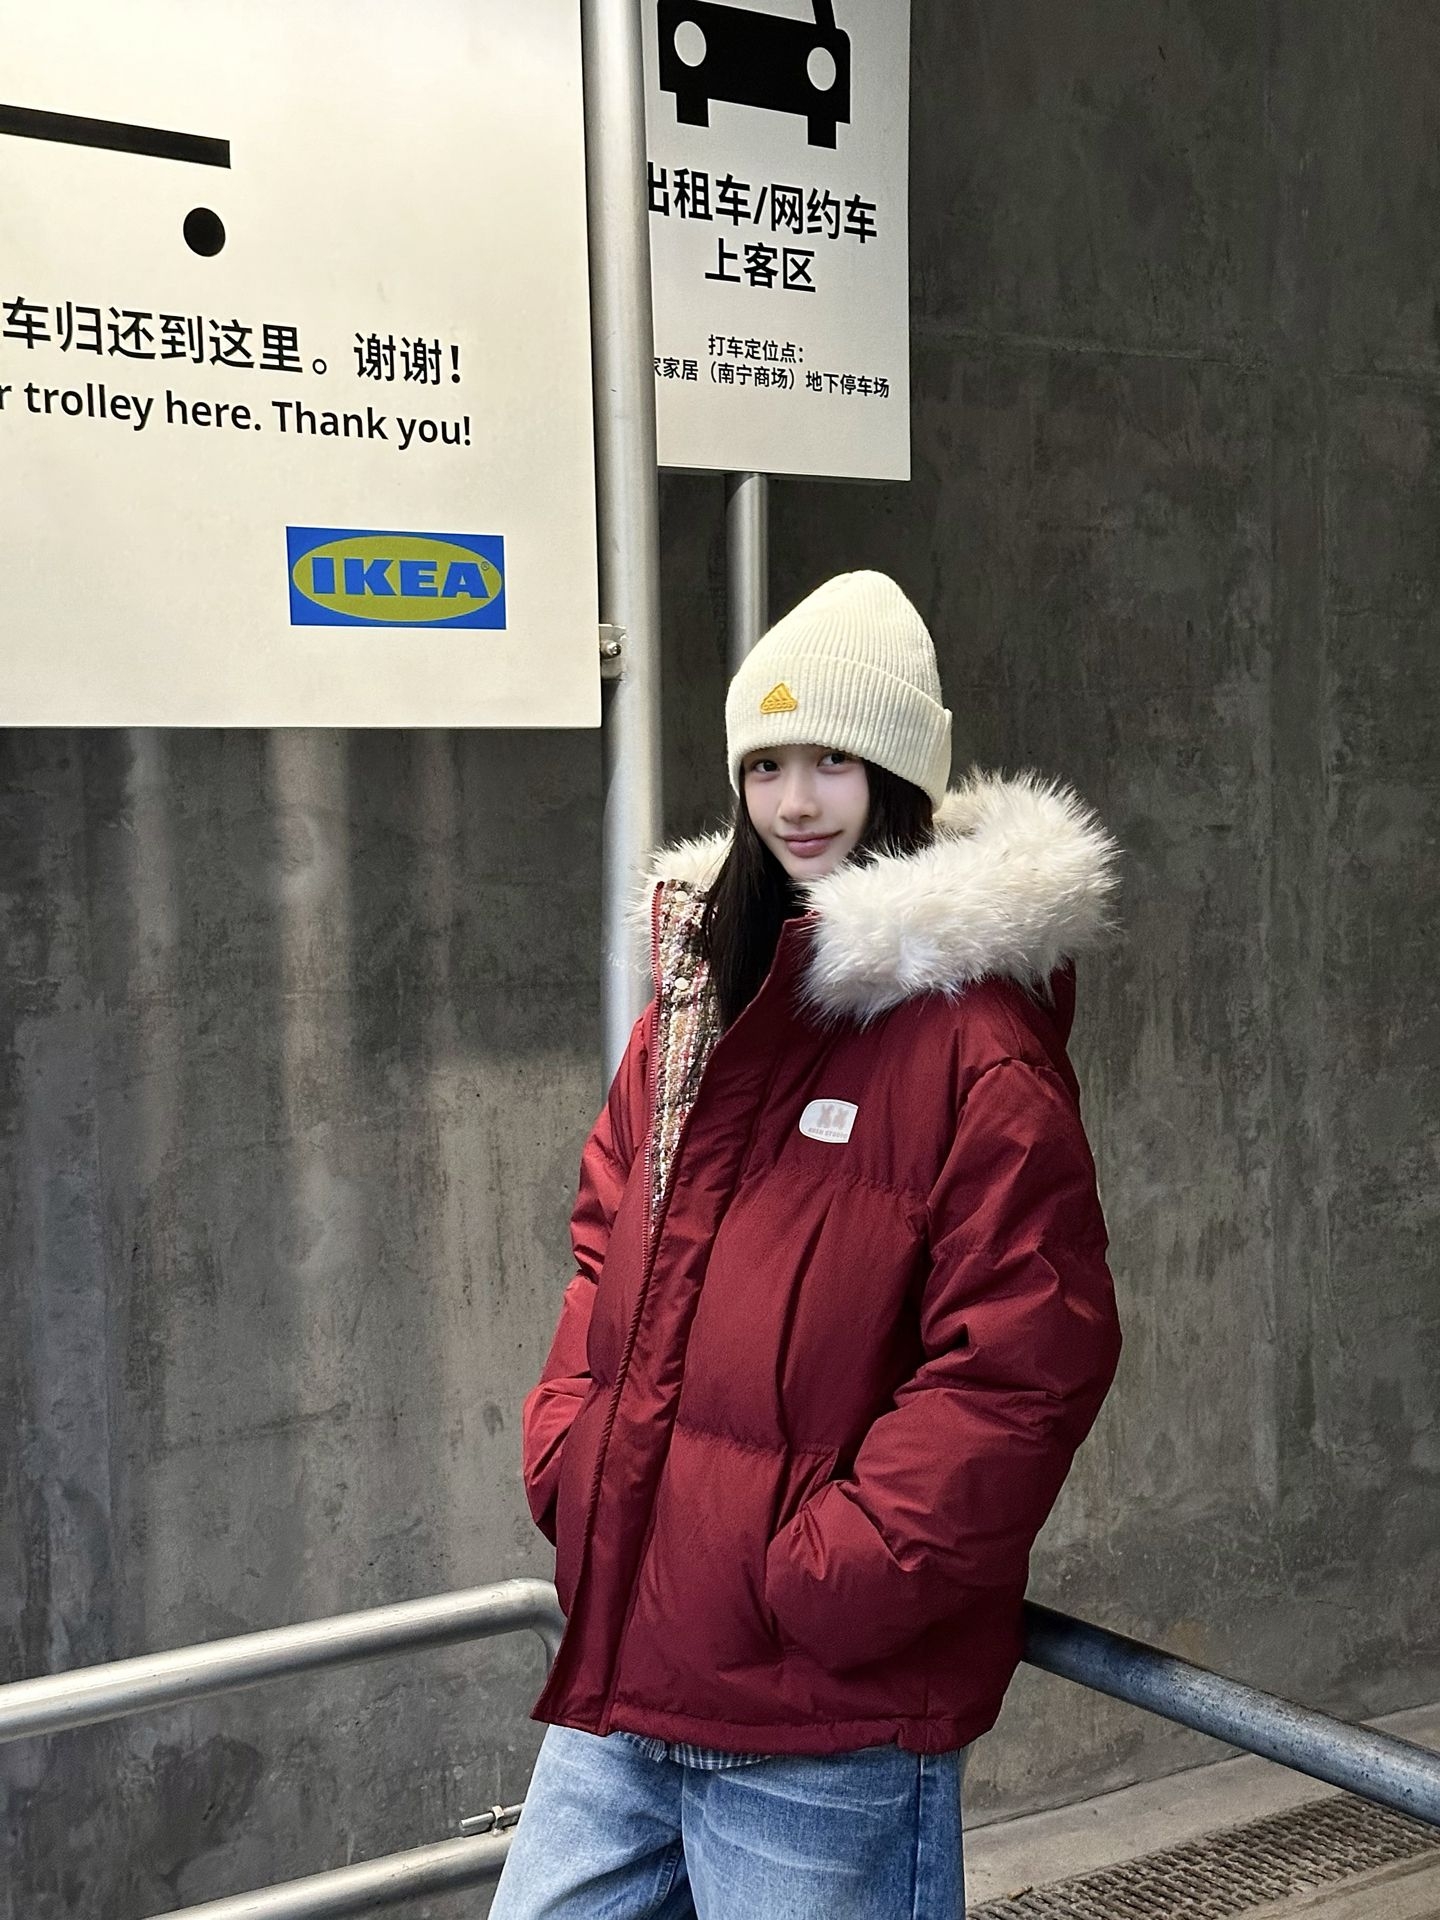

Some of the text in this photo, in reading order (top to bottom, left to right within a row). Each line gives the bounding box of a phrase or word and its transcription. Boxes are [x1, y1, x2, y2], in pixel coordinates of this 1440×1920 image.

[705, 238, 815, 292] 上客区
[709, 334, 803, 363] 打车定位点：
[24, 382, 154, 431] trolley
[166, 389, 262, 431] here.
[272, 401, 389, 440] Thank
[396, 416, 471, 450] you!
[312, 557, 490, 598] IKEA
